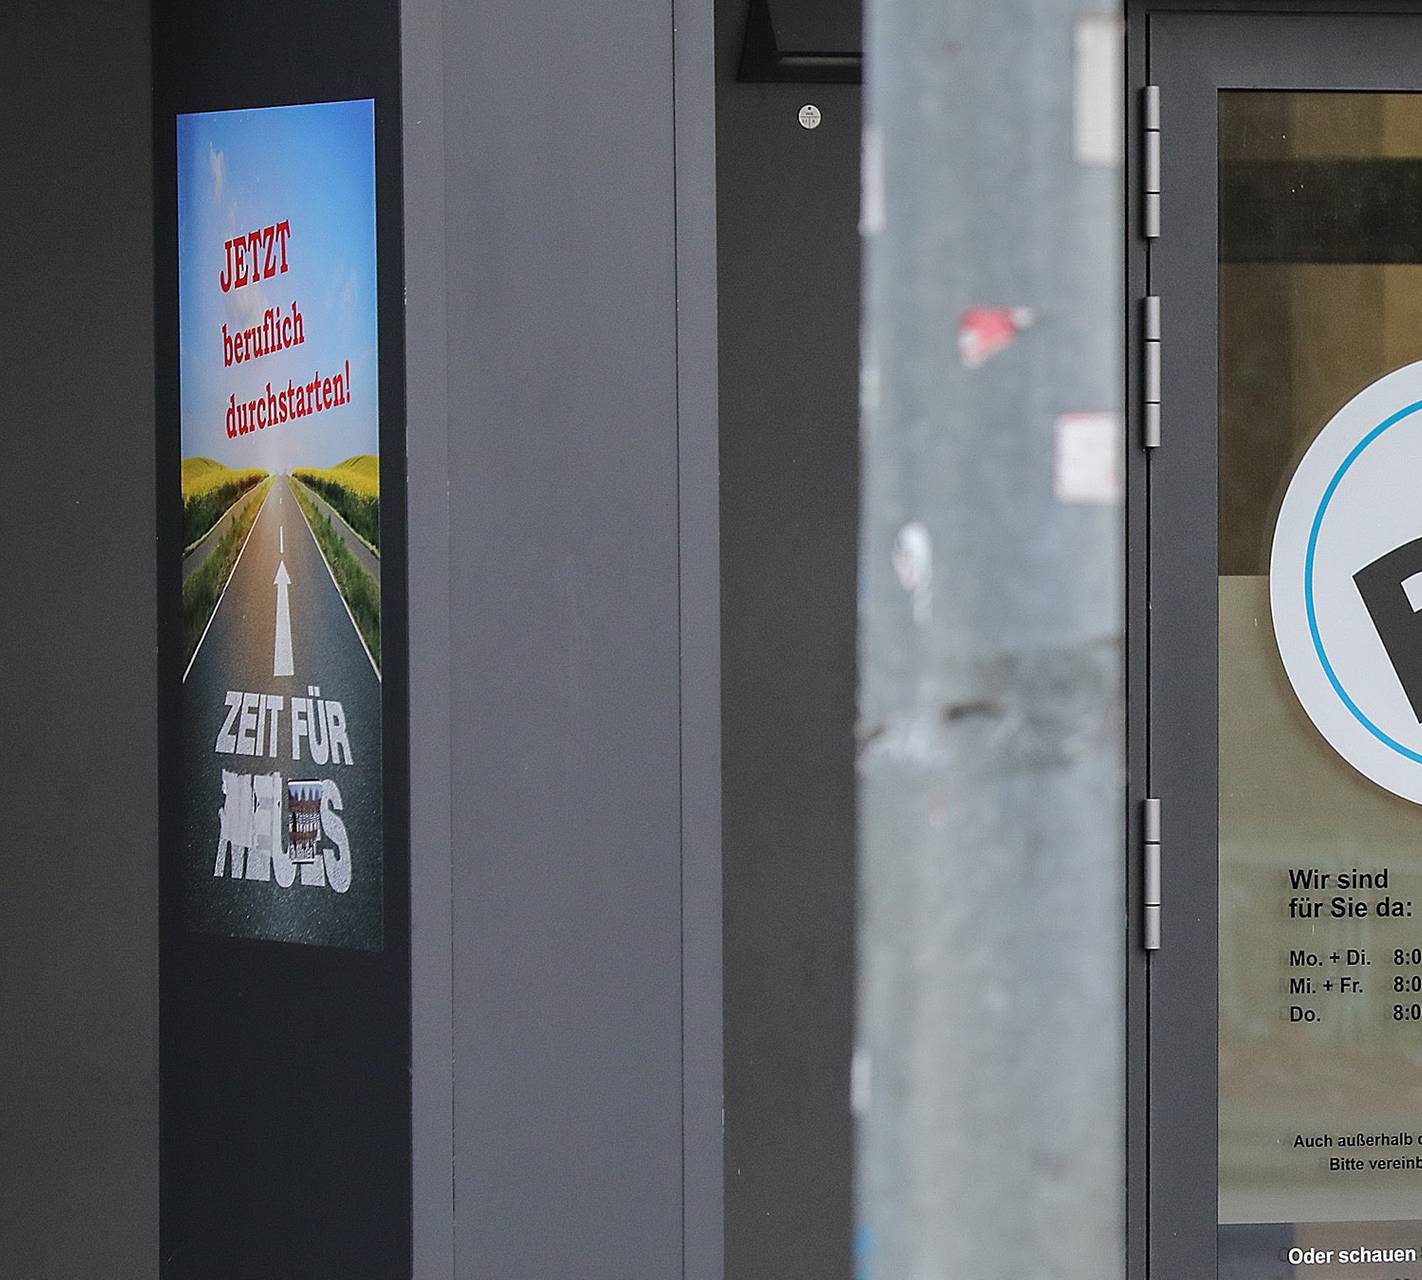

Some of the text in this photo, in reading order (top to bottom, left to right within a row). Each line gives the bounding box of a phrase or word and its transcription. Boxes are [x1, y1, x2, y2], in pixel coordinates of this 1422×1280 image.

[220, 219, 291, 293] JETZT
[222, 301, 304, 367] beruflich
[225, 360, 351, 439] durchstarten!
[215, 686, 354, 766] ZEIT FÜR
[1288, 868, 1389, 890] Wir sind
[1288, 896, 1413, 918] für Sie da:
[1289, 949, 1371, 967] Mo. + Di.
[1289, 977, 1364, 994] Mi. + Fr.
[1289, 1007, 1321, 1023] Do.
[1293, 1133, 1333, 1149] Auch
[1338, 1131, 1412, 1148] außerhalb
[1329, 1157, 1364, 1172] Bitte
[1288, 1247, 1334, 1266] Oder
[1338, 1246, 1416, 1264] schauen
